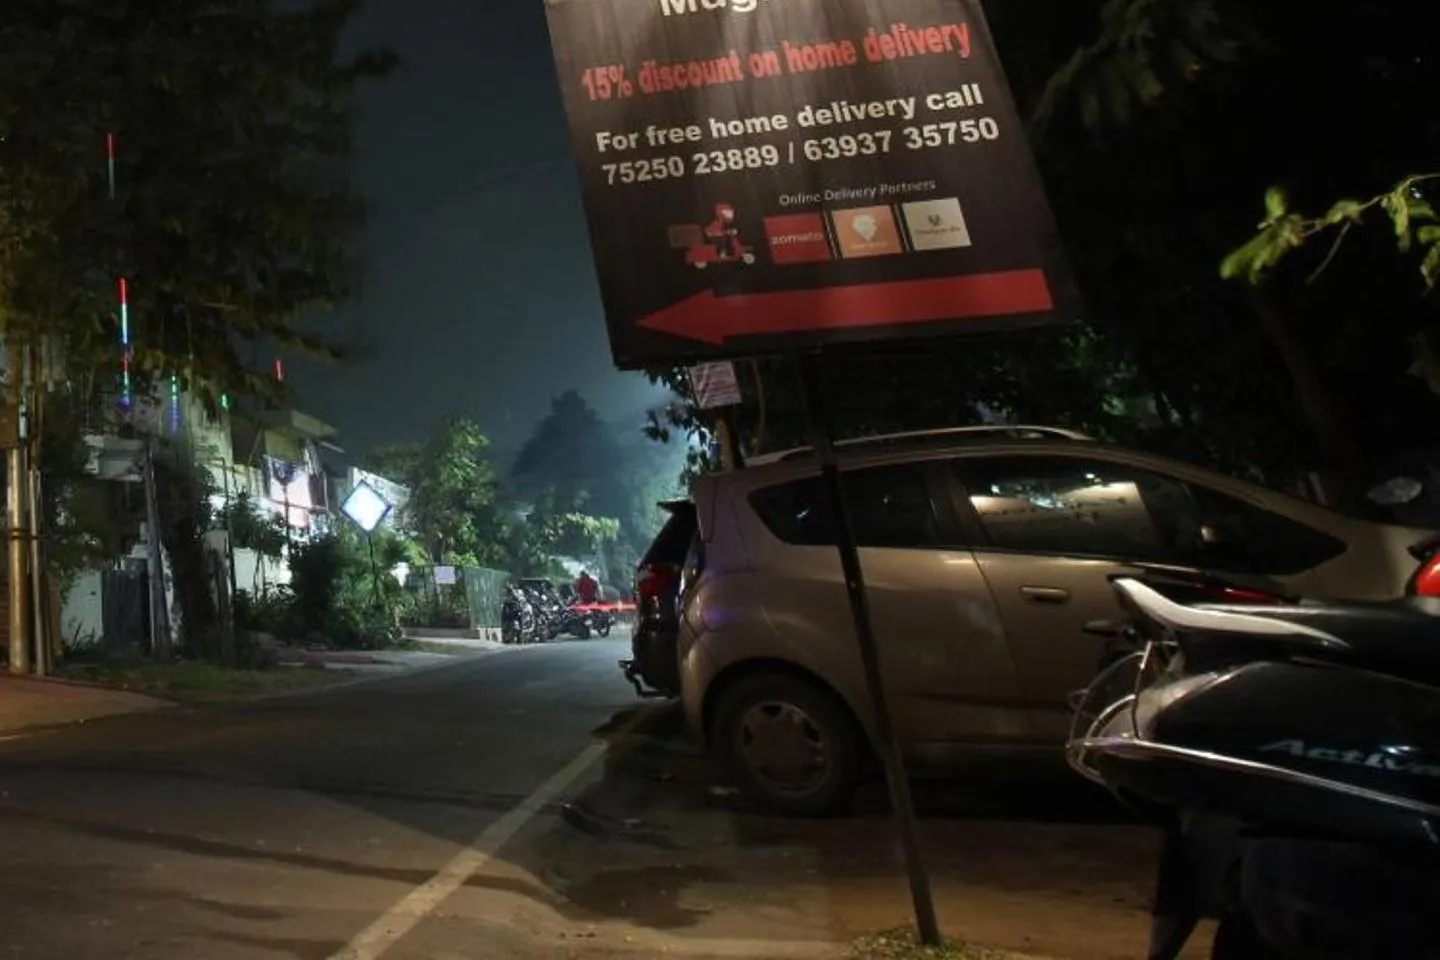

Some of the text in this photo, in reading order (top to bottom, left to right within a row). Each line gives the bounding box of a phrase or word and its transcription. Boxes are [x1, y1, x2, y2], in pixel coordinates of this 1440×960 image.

[582, 20, 971, 101] 15% discount on home delivery
[596, 83, 984, 153] For free home delivery call
[602, 156, 685, 186] 75250
[693, 144, 780, 176] 23889
[804, 129, 892, 163] 63937
[902, 115, 1000, 152] 35750
[778, 179, 937, 206] Online Delivery Partners
